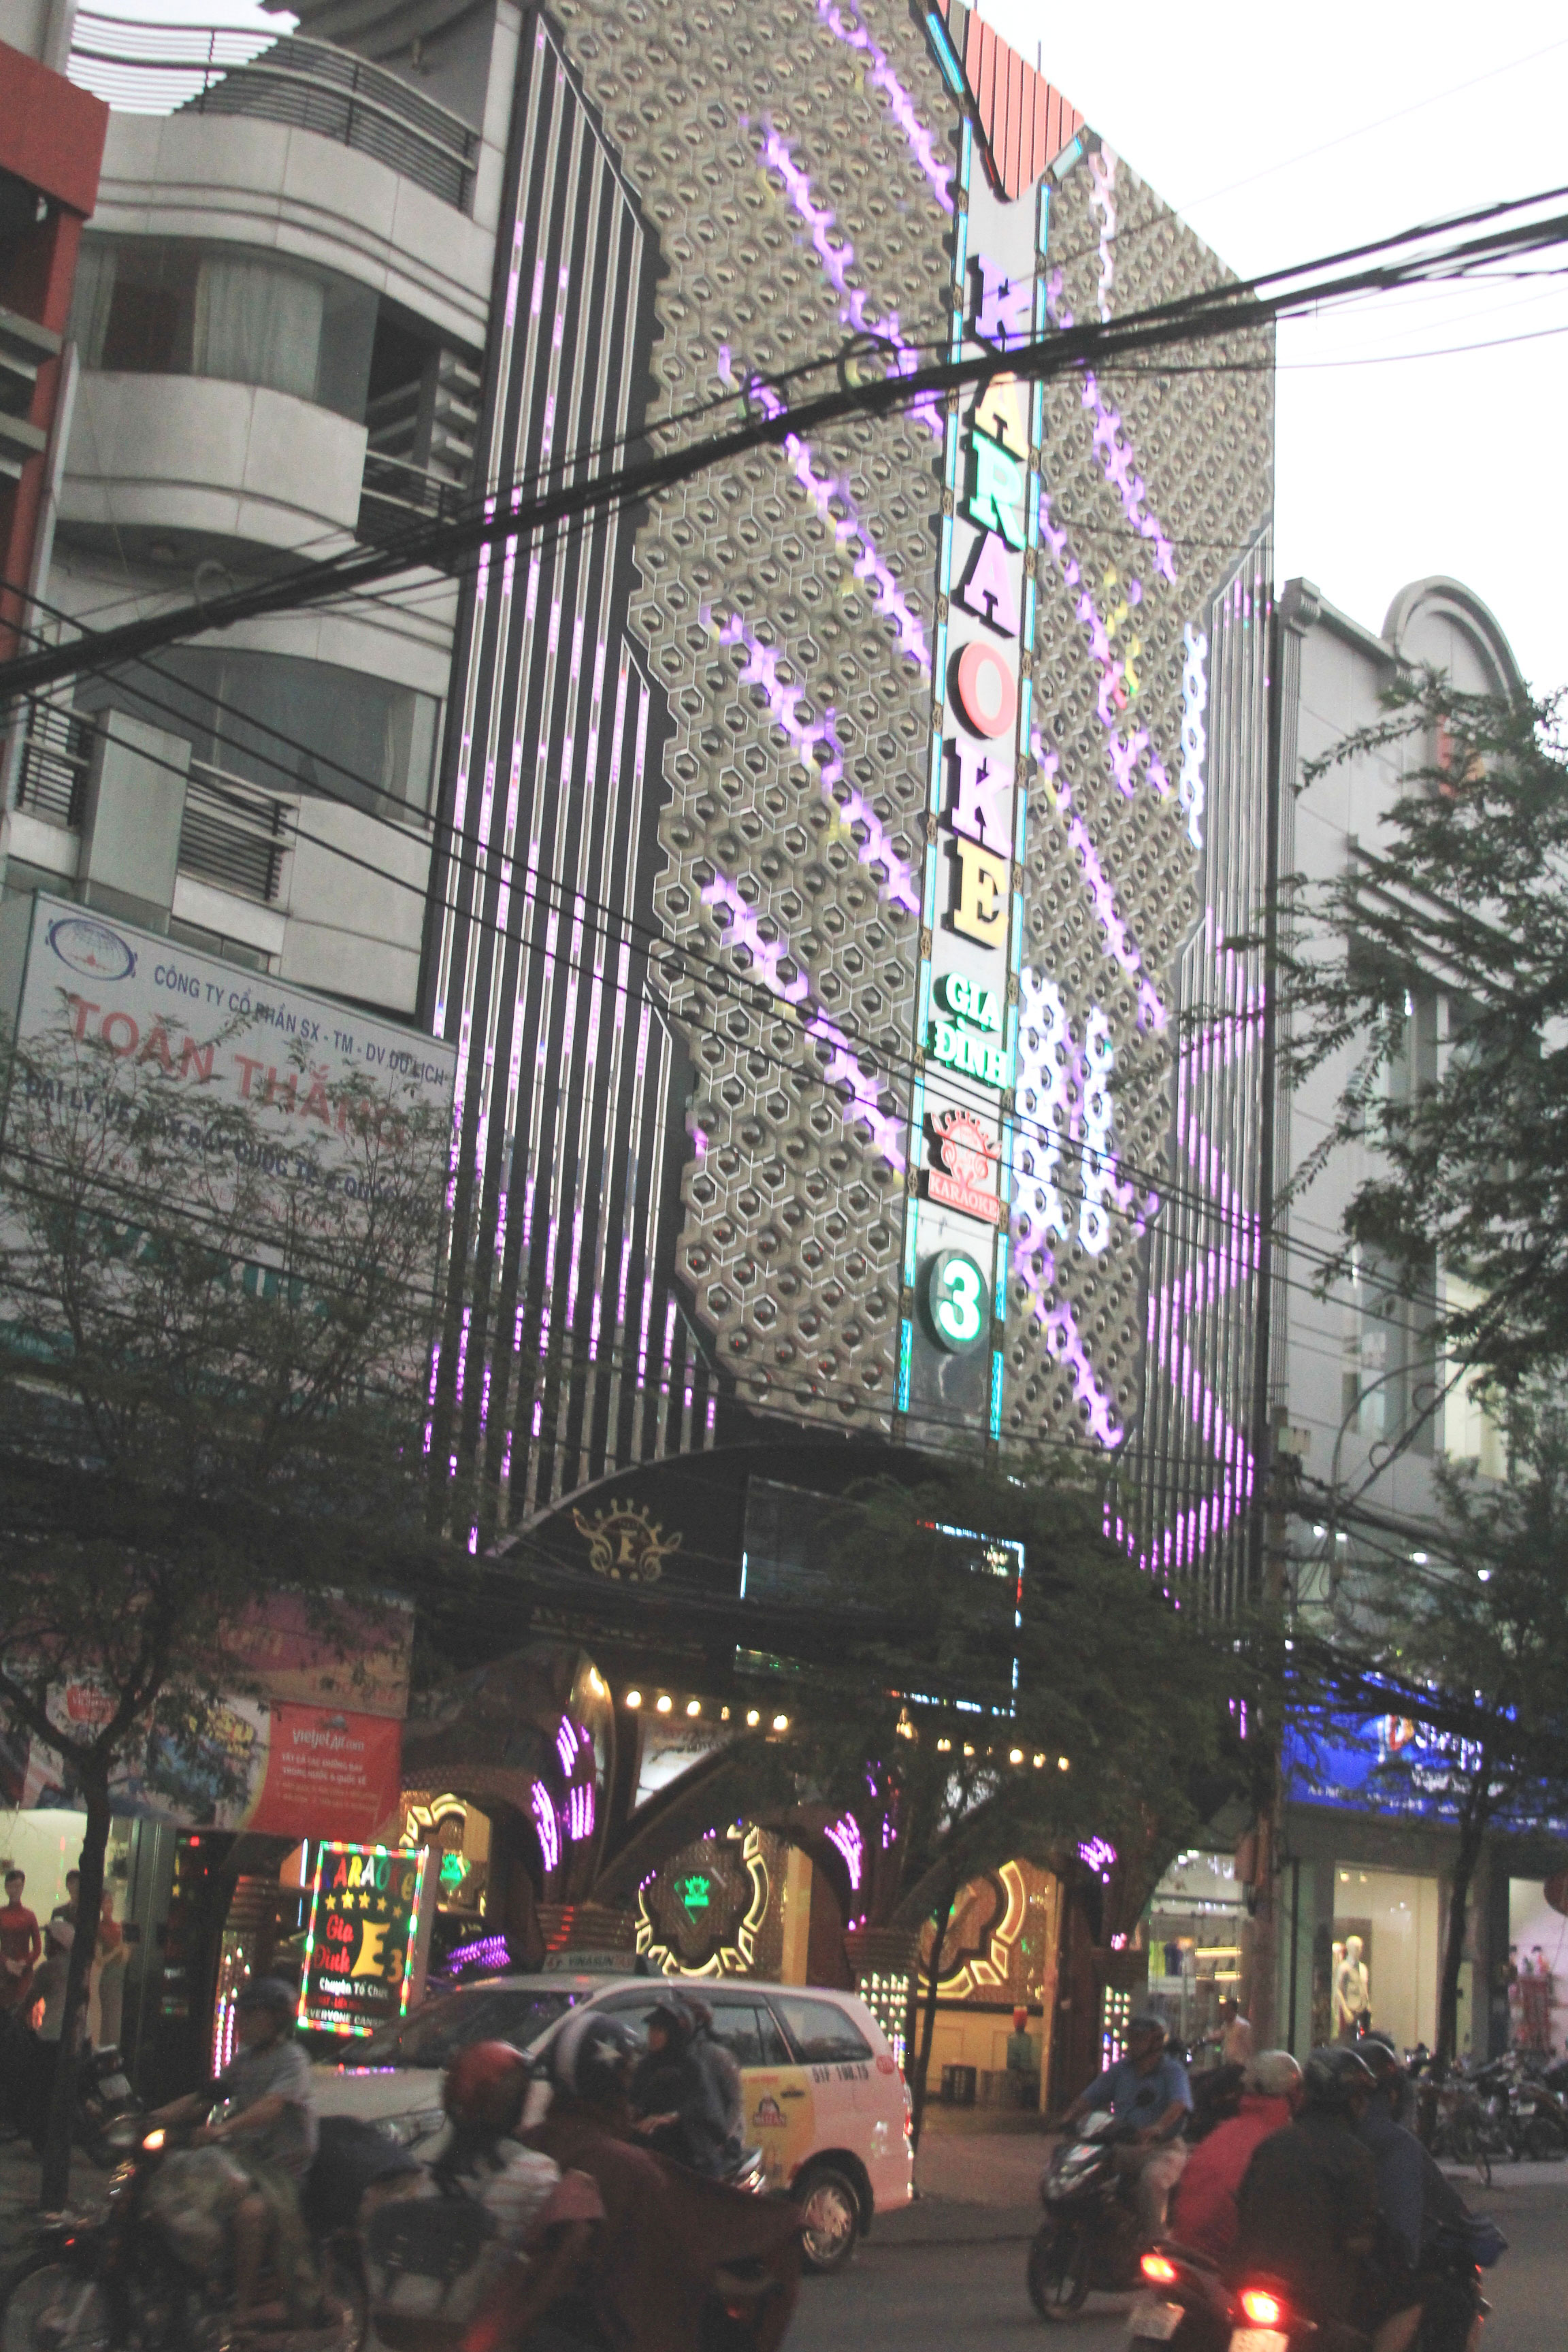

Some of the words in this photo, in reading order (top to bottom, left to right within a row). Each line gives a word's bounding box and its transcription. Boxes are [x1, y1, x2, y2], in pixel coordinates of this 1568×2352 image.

[952, 252, 1034, 949] KARAOKE
[154, 964, 200, 998] CÔNG
[206, 983, 225, 1007] TY
[300, 1020, 322, 1042] SX
[333, 1030, 353, 1054] TM
[946, 972, 1003, 1032] GIA
[930, 1172, 998, 1222] KARAOKE
[938, 1258, 981, 1341] 3
